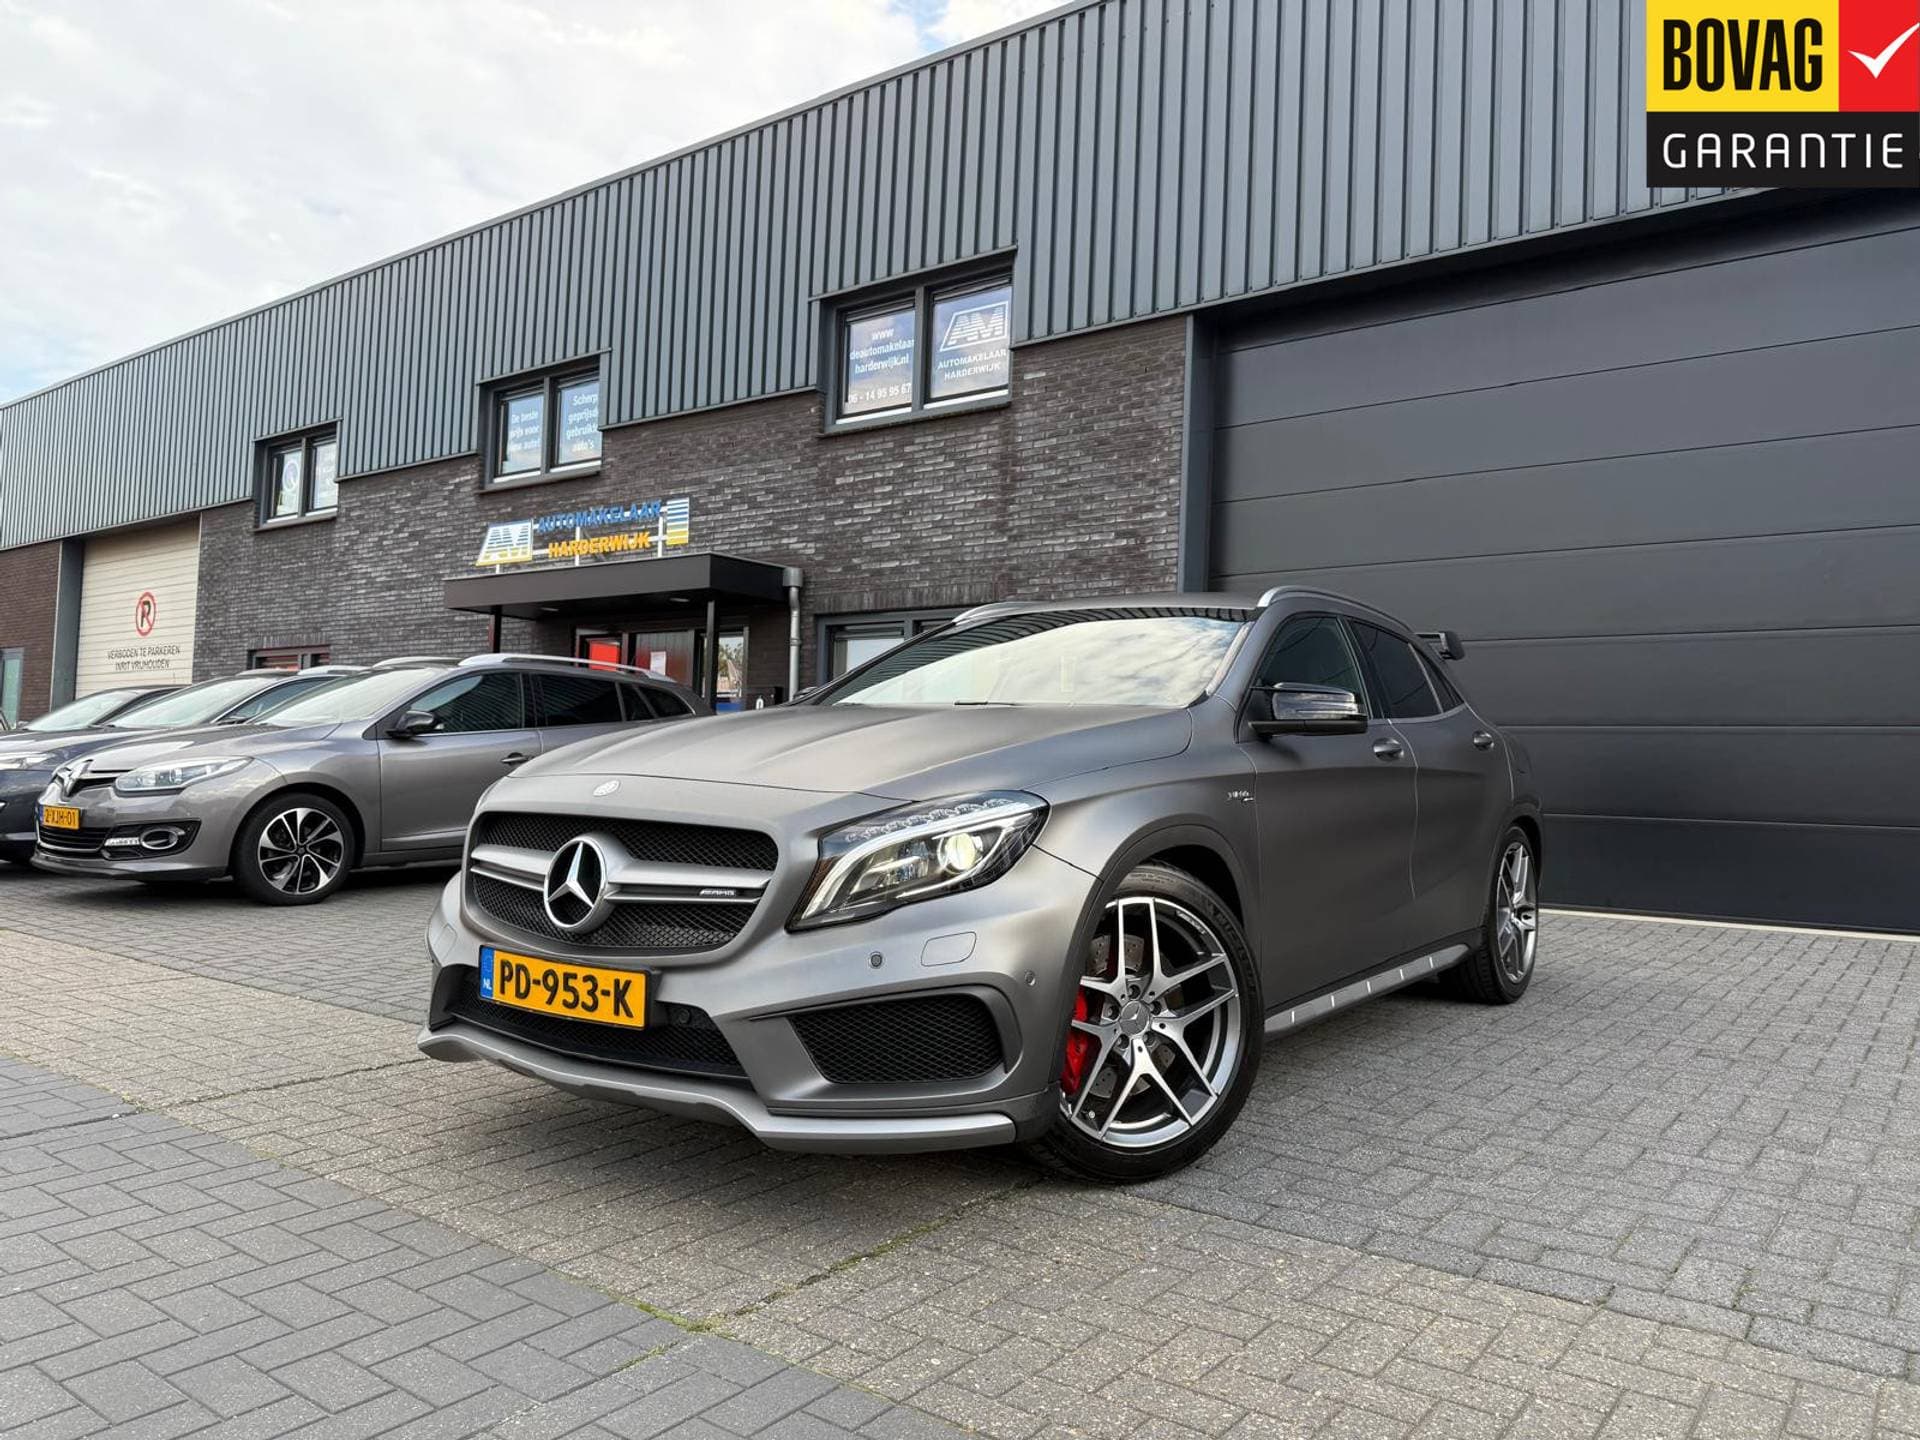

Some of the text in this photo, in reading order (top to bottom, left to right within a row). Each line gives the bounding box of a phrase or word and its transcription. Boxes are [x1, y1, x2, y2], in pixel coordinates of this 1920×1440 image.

[937, 349, 1007, 370] AUTOMAKELAAR
[944, 362, 1001, 381] HARDERWIJK
[537, 500, 661, 533] AUTOMAKELAAR
[548, 531, 651, 558] HARDERWIJK
[108, 645, 180, 659] VERBODEN TE PARKEREN
[483, 978, 492, 990] NL
[500, 959, 634, 1018] PD-953-K
